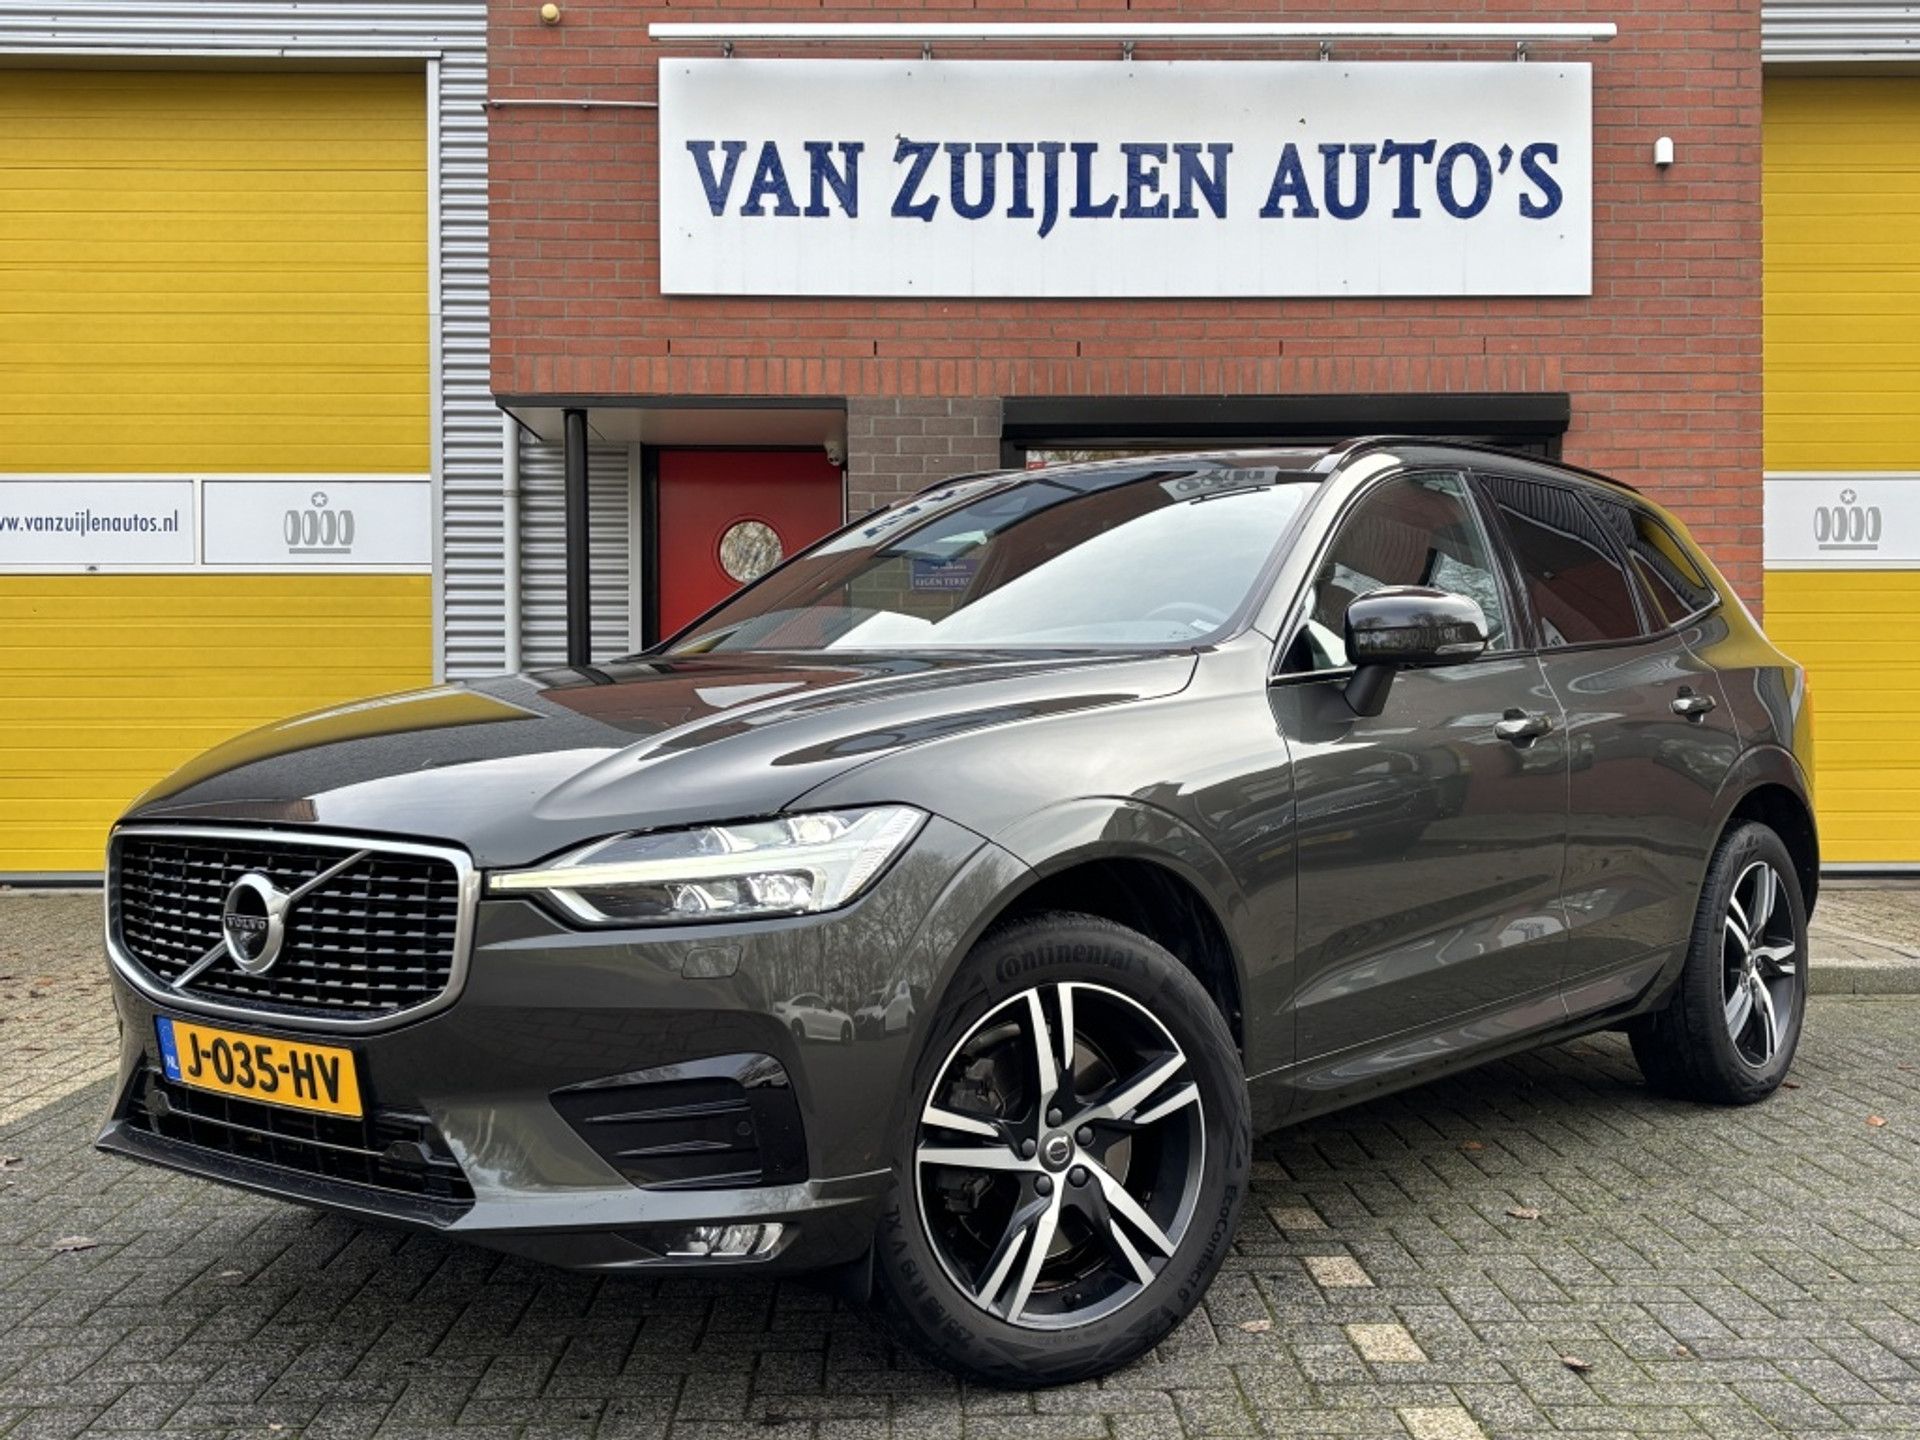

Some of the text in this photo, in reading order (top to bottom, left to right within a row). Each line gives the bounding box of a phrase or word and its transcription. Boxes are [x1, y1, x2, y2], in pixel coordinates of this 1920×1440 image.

[685, 134, 1564, 239] VAN ZUIJLEN AUTO'S
[226, 916, 267, 930] VOLVO
[995, 941, 1134, 983] Continental
[165, 1054, 179, 1070] NL
[188, 1032, 339, 1103] J-035-HV
[885, 1204, 904, 1233] XL
[1178, 1184, 1237, 1303] EcoContact 6
